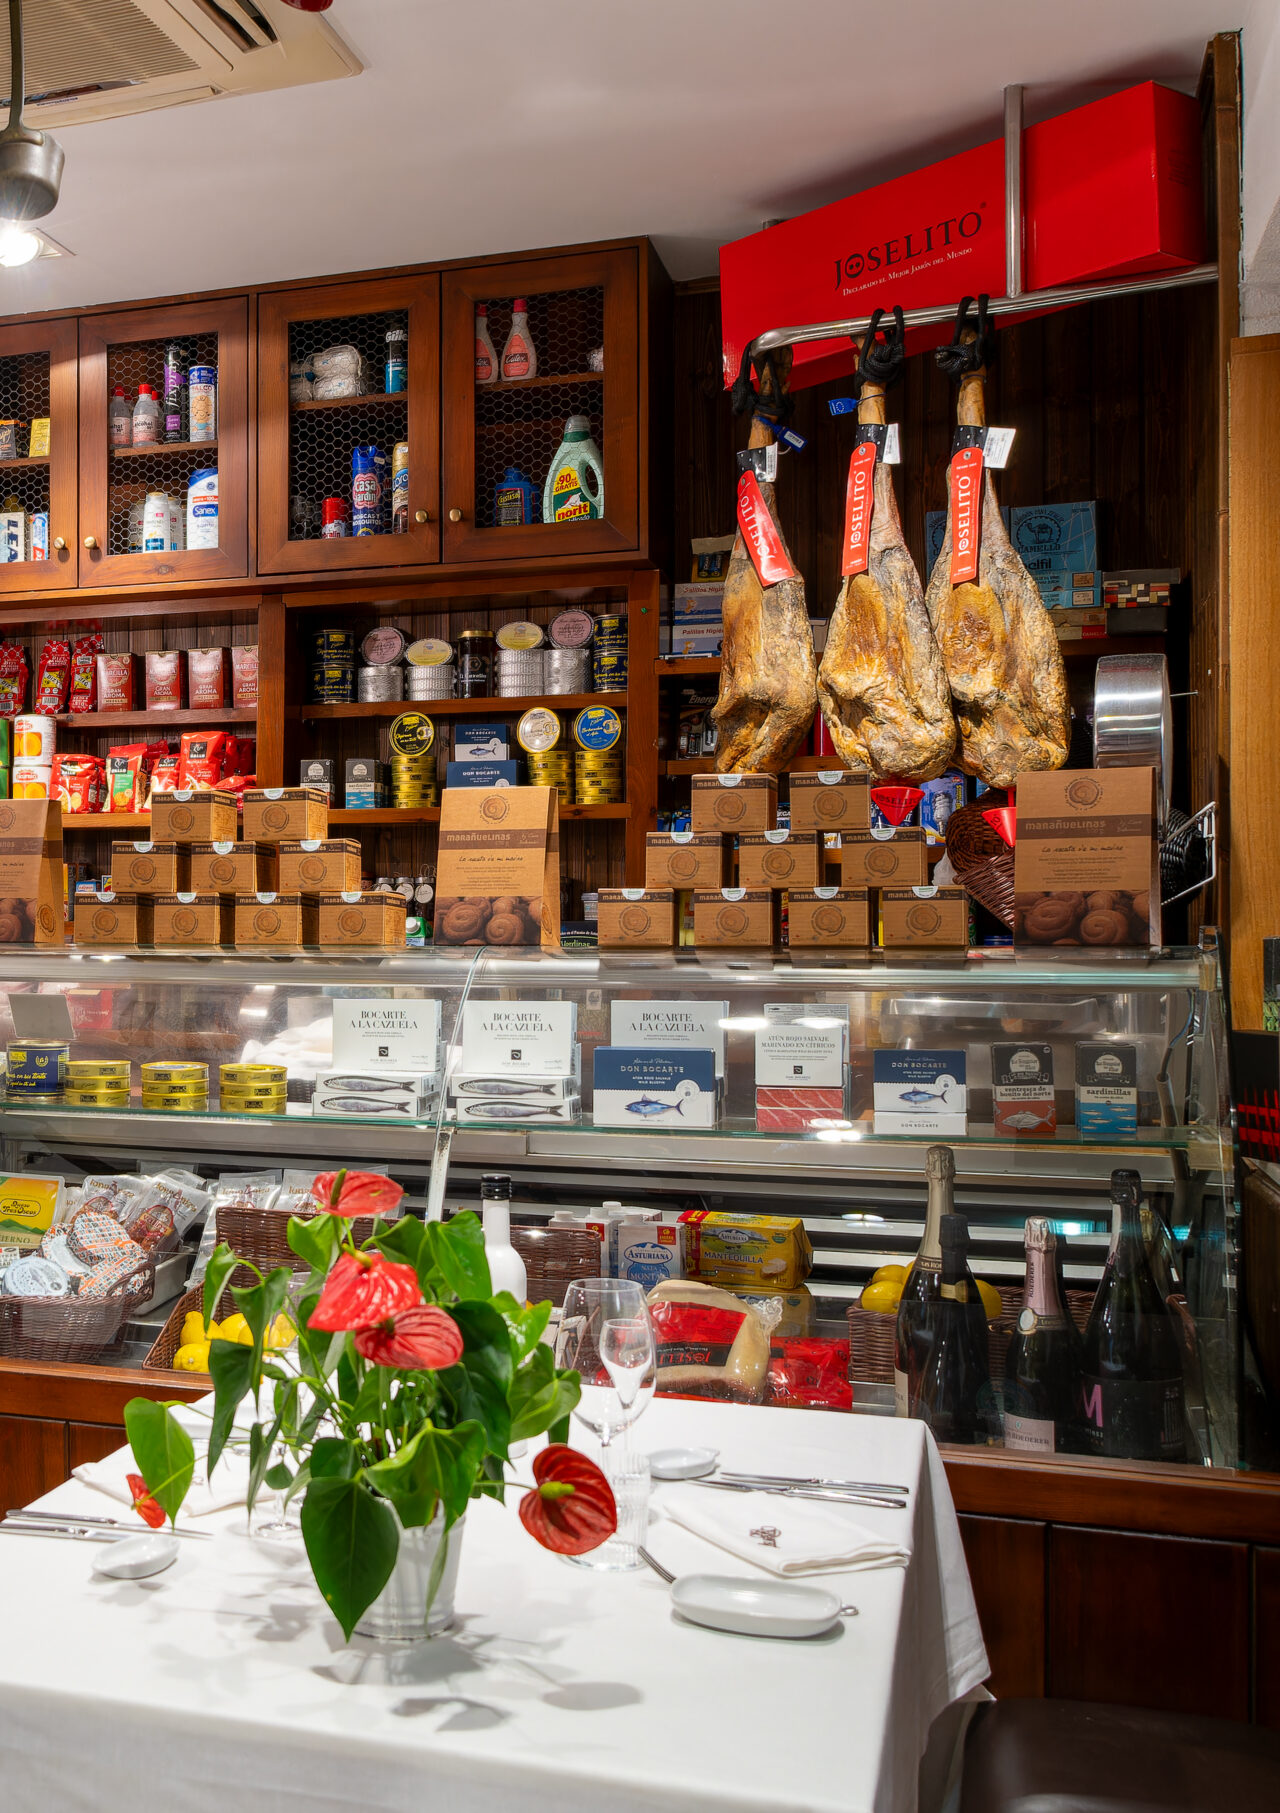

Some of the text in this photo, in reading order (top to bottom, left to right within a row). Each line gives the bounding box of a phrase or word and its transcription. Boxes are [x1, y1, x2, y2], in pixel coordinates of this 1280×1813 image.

[834, 212, 982, 290] JOSELITO
[354, 479, 376, 492] casa
[194, 506, 216, 515] Sanex
[557, 503, 589, 521] norit
[851, 470, 867, 550] JOSELITO
[958, 474, 971, 557] JOSELITO
[740, 495, 775, 562] JOSELITO
[361, 1010, 407, 1020] BOCARTE
[493, 1012, 542, 1022] BOCARTE
[642, 1012, 693, 1022] BOCARTE
[350, 1020, 418, 1029] A LA CAZUELA
[480, 1023, 554, 1032] A LA CAZUELA
[629, 1022, 705, 1032] A LA CAZUELA
[785, 1034, 803, 1042] ROJO
[803, 1035, 830, 1043] SALVAJE
[620, 1065, 640, 1073] DON
[1086, 1088, 1132, 1096] sardinillas
[627, 1249, 670, 1260] ASTURIANA
[703, 1252, 764, 1264] MANTEQUILLA
